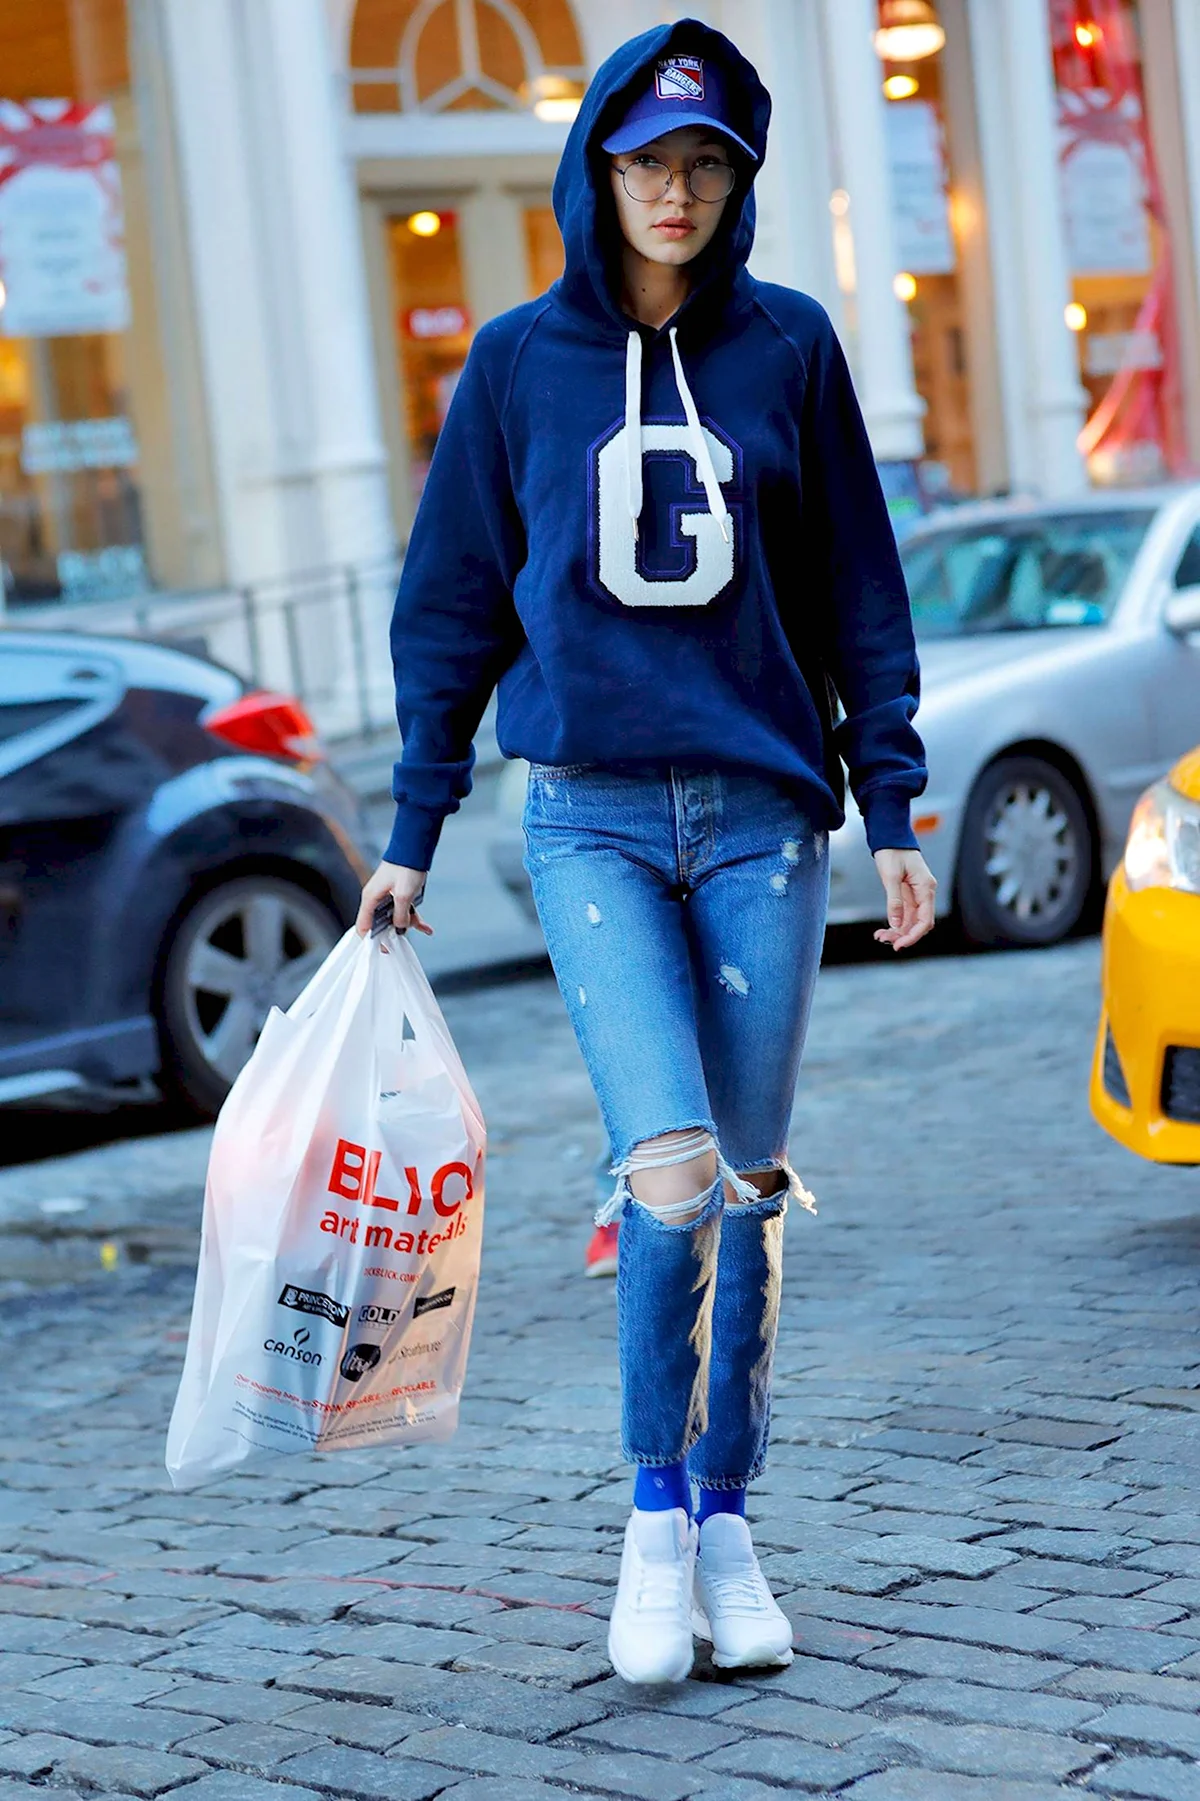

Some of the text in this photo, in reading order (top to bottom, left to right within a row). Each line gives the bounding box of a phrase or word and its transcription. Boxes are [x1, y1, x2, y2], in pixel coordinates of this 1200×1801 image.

[657, 57, 700, 69] NEW YORK
[664, 68, 702, 96] RANGERS
[597, 423, 735, 608] G
[328, 1137, 482, 1218] BLIC
[319, 1210, 468, 1256] art mateals
[298, 1291, 348, 1319] PRINCETON
